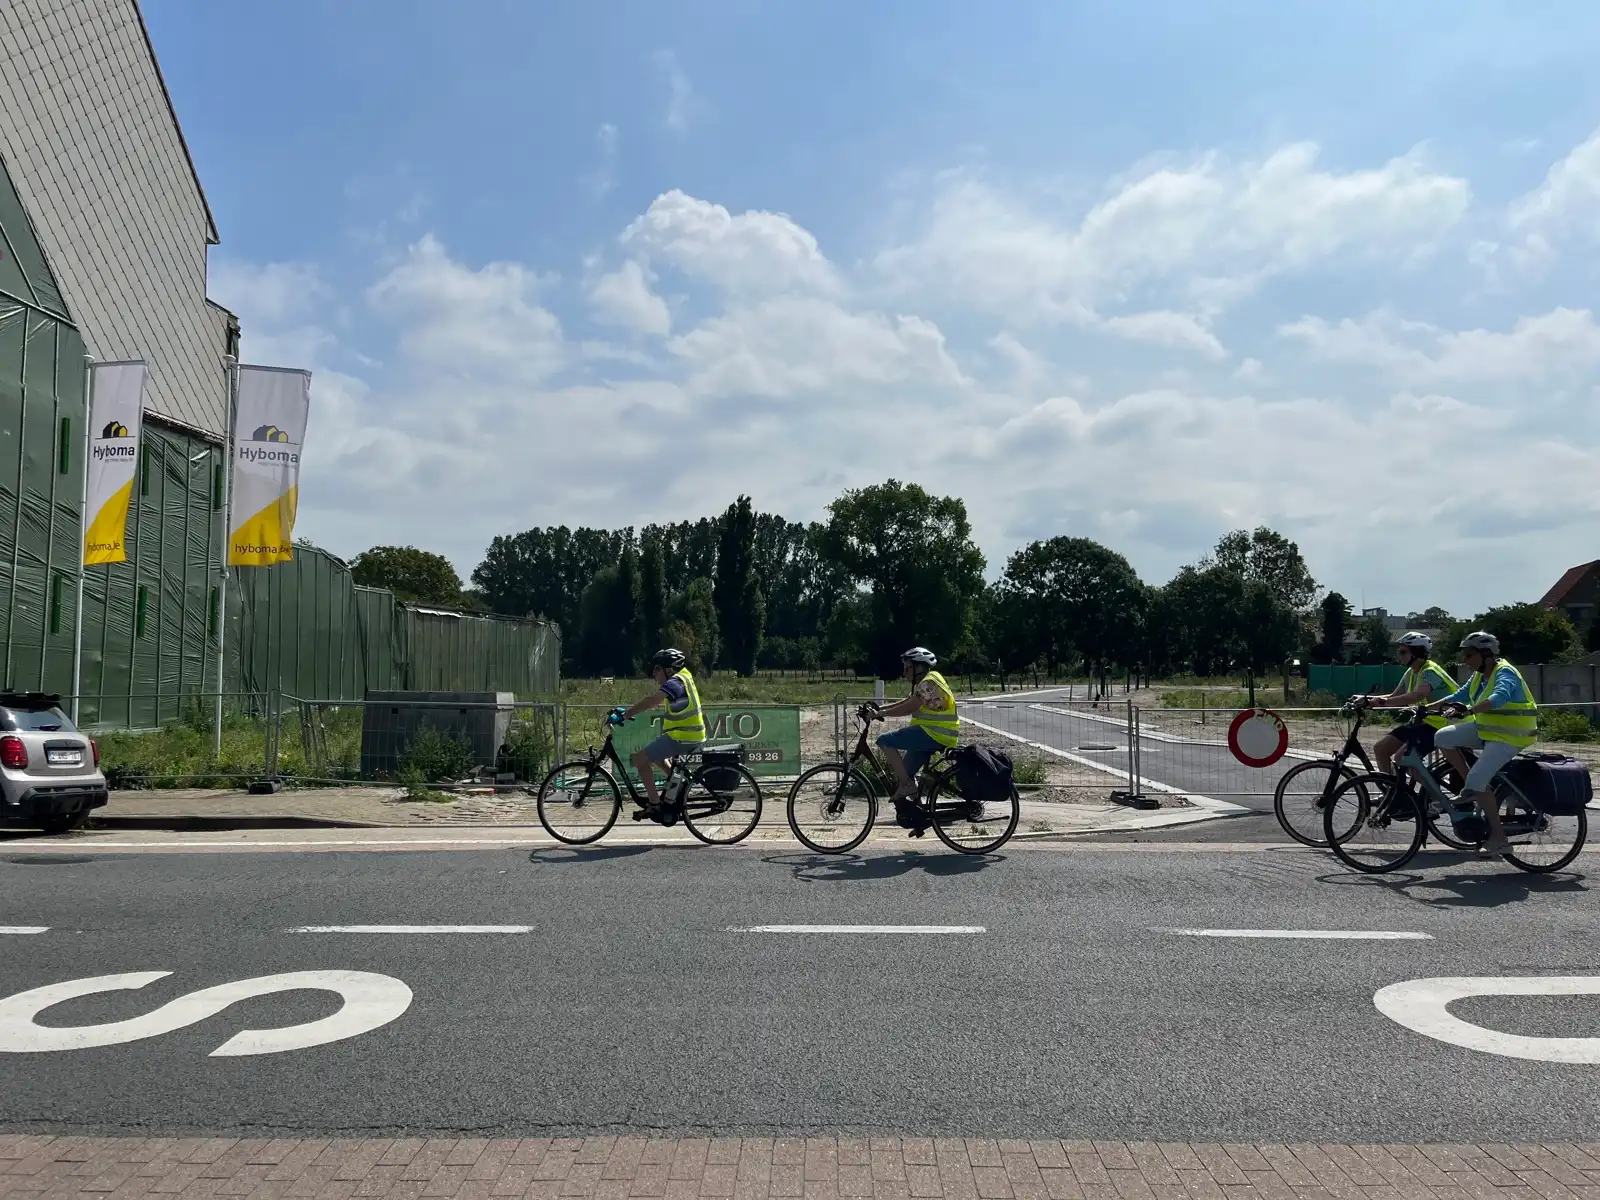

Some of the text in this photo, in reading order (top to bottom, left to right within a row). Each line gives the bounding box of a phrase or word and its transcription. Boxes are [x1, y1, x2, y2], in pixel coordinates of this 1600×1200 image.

[240, 447, 298, 463] Hyboma
[748, 752, 762, 761] 93
[764, 752, 779, 761] 26
